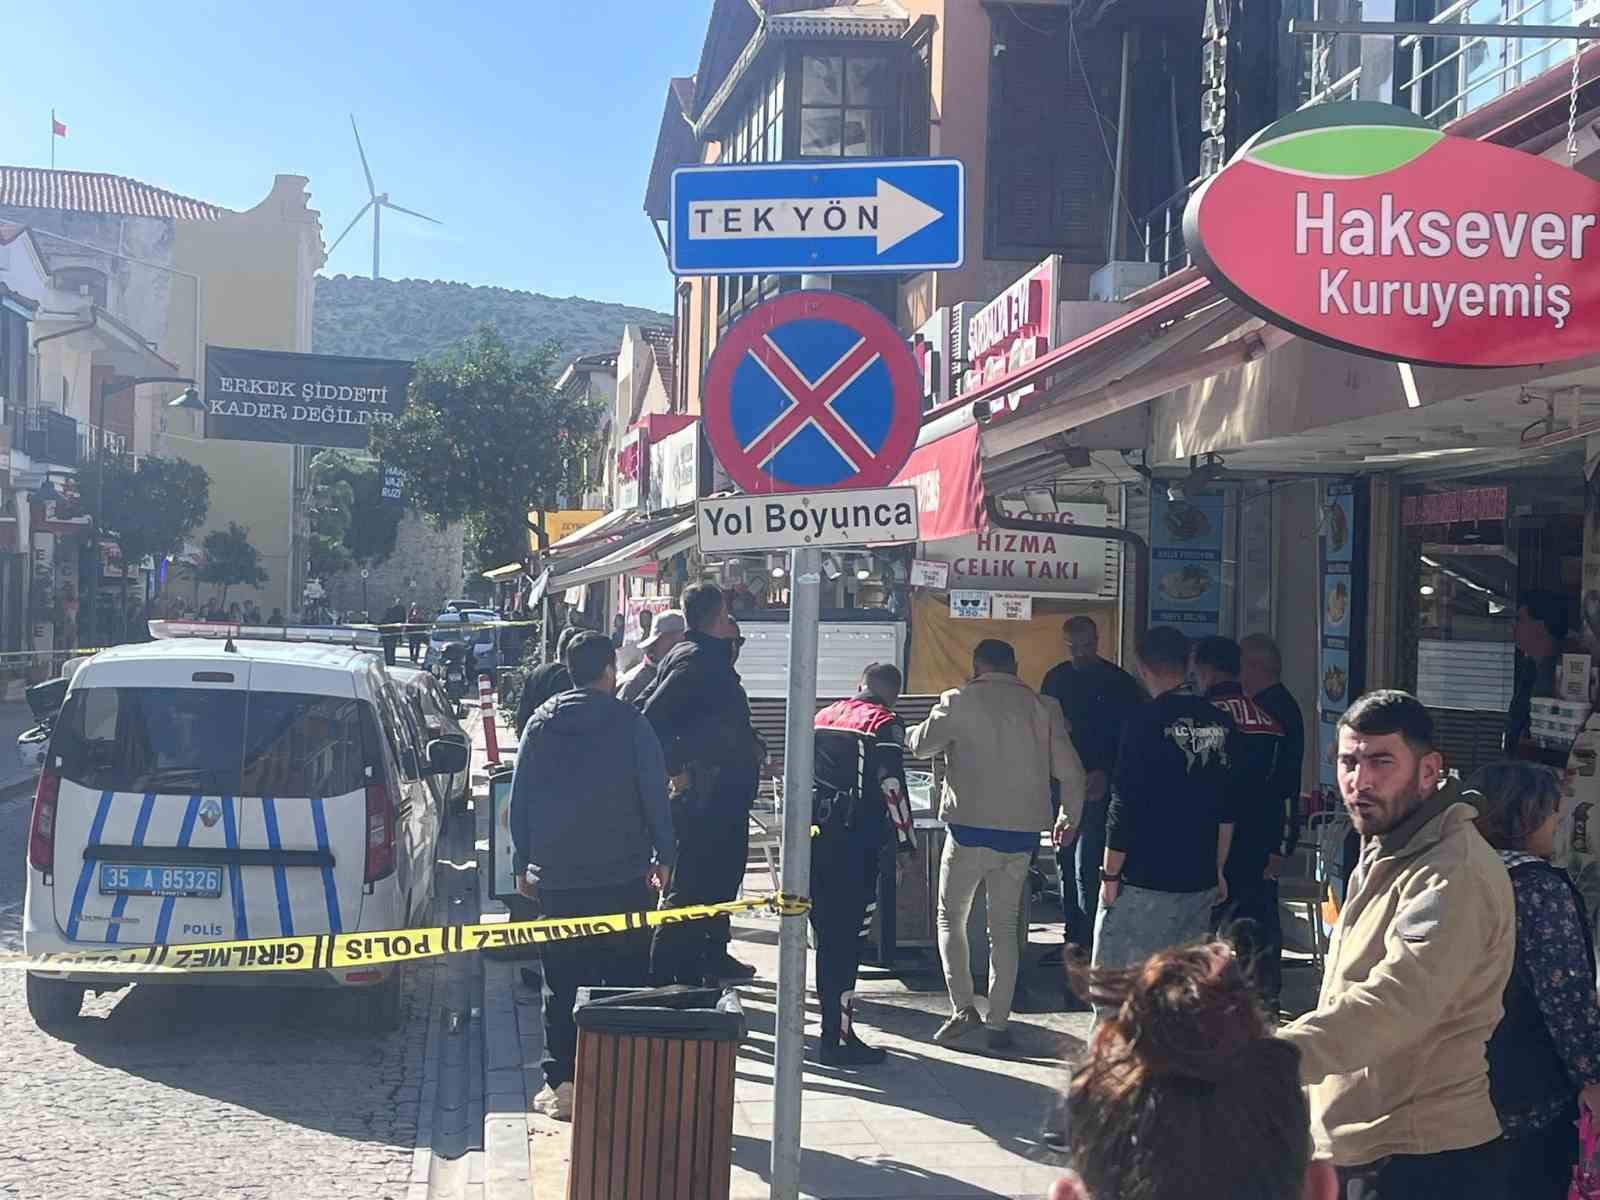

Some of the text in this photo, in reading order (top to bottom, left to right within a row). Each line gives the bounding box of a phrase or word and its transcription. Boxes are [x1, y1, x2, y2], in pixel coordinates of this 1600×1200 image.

[695, 200, 878, 233] TEK YÖN
[1295, 192, 1596, 260] Haksever
[1320, 268, 1571, 329] Kuruyemiş
[219, 377, 388, 404] ERKEK ŞİDDETİ
[209, 400, 288, 420] KADER
[704, 501, 913, 538] Yol Boyunca
[977, 534, 1057, 554] HIZMA
[1025, 560, 1079, 580] TAKI
[107, 868, 217, 890] 35 A 85326
